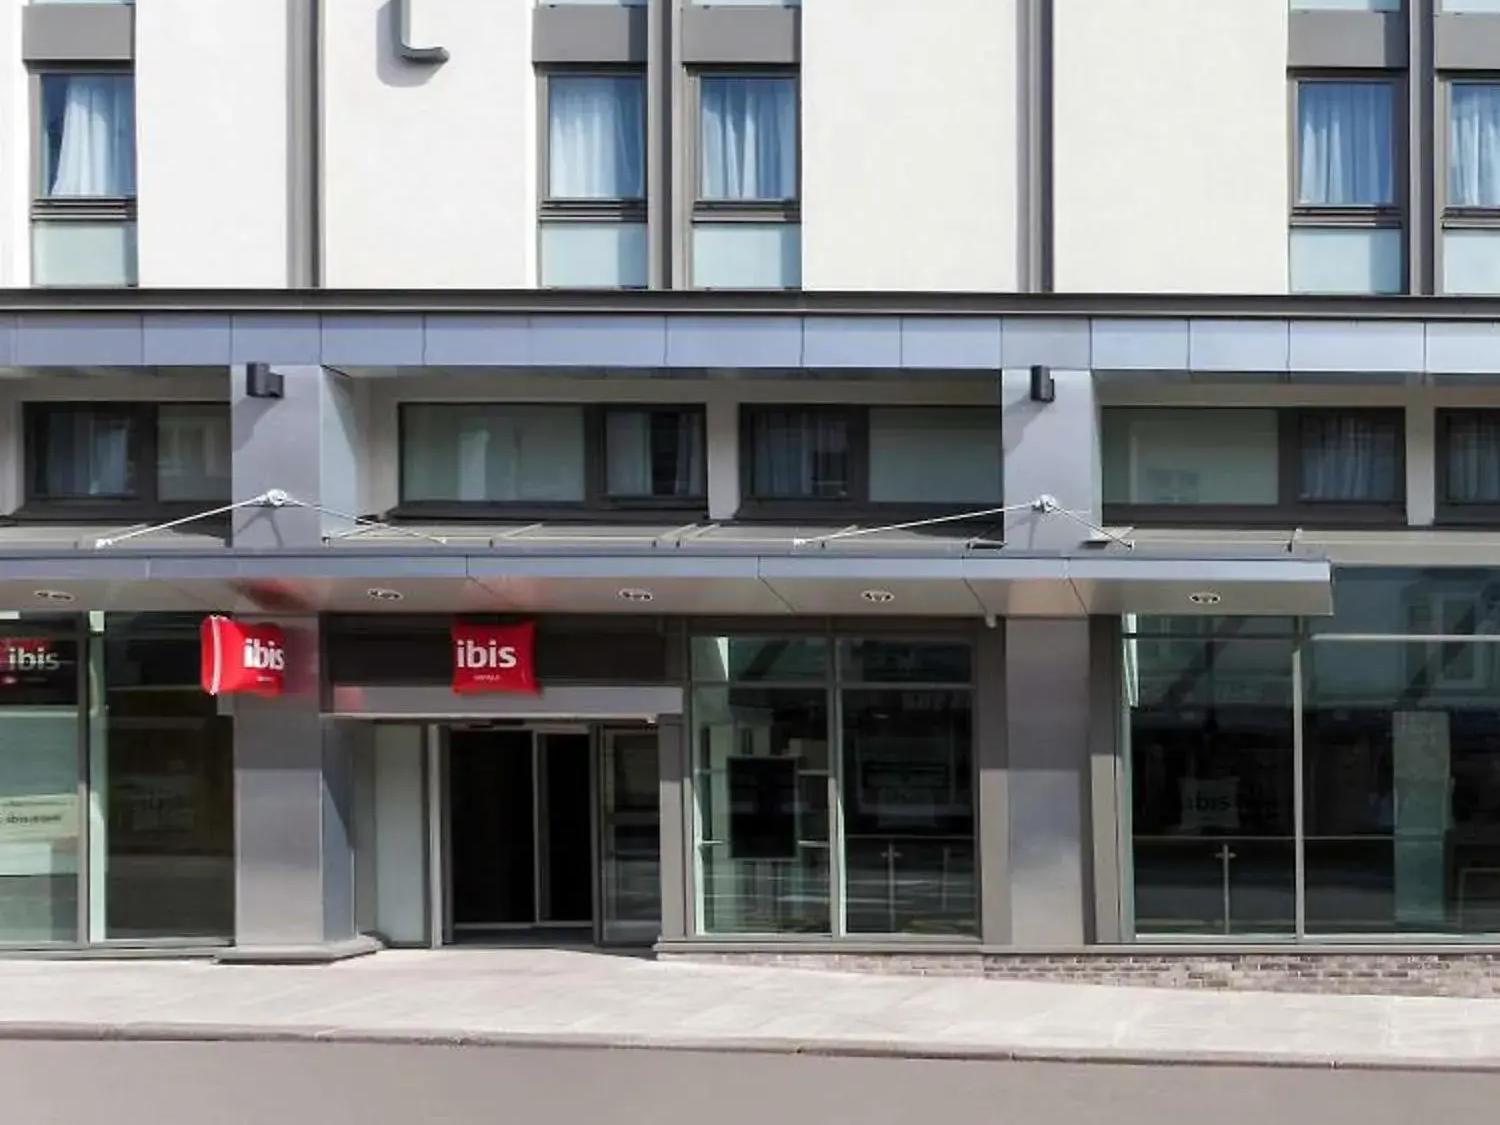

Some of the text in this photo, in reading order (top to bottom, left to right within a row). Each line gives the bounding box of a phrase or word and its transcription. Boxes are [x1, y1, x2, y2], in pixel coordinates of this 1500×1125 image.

[8, 646, 60, 671] ibis
[243, 637, 285, 671] ibis
[456, 639, 517, 668] ibis
